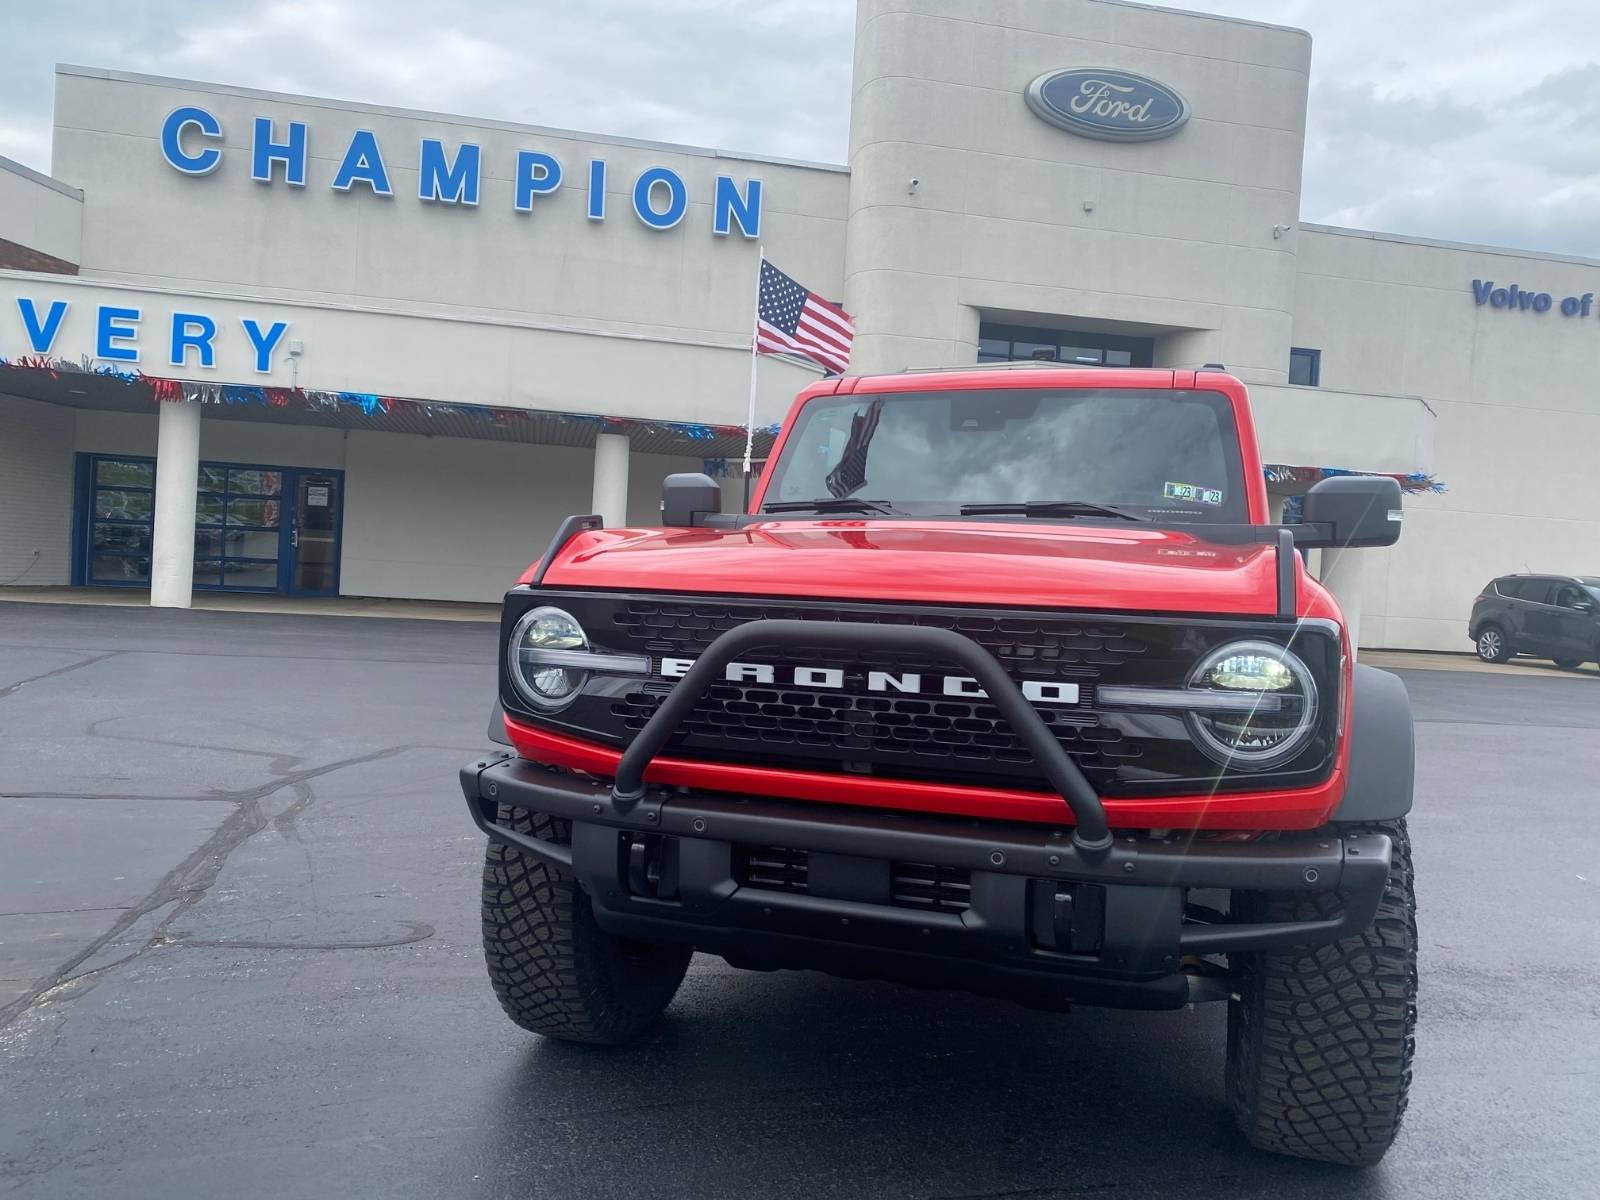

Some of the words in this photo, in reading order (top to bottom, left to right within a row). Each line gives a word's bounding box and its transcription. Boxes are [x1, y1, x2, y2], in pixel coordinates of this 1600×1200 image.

[1070, 79, 1154, 122] Ford
[160, 106, 764, 240] CHAMPION
[1472, 279, 1553, 313] Volvo
[1560, 292, 1595, 317] of
[15, 297, 289, 374] VERY
